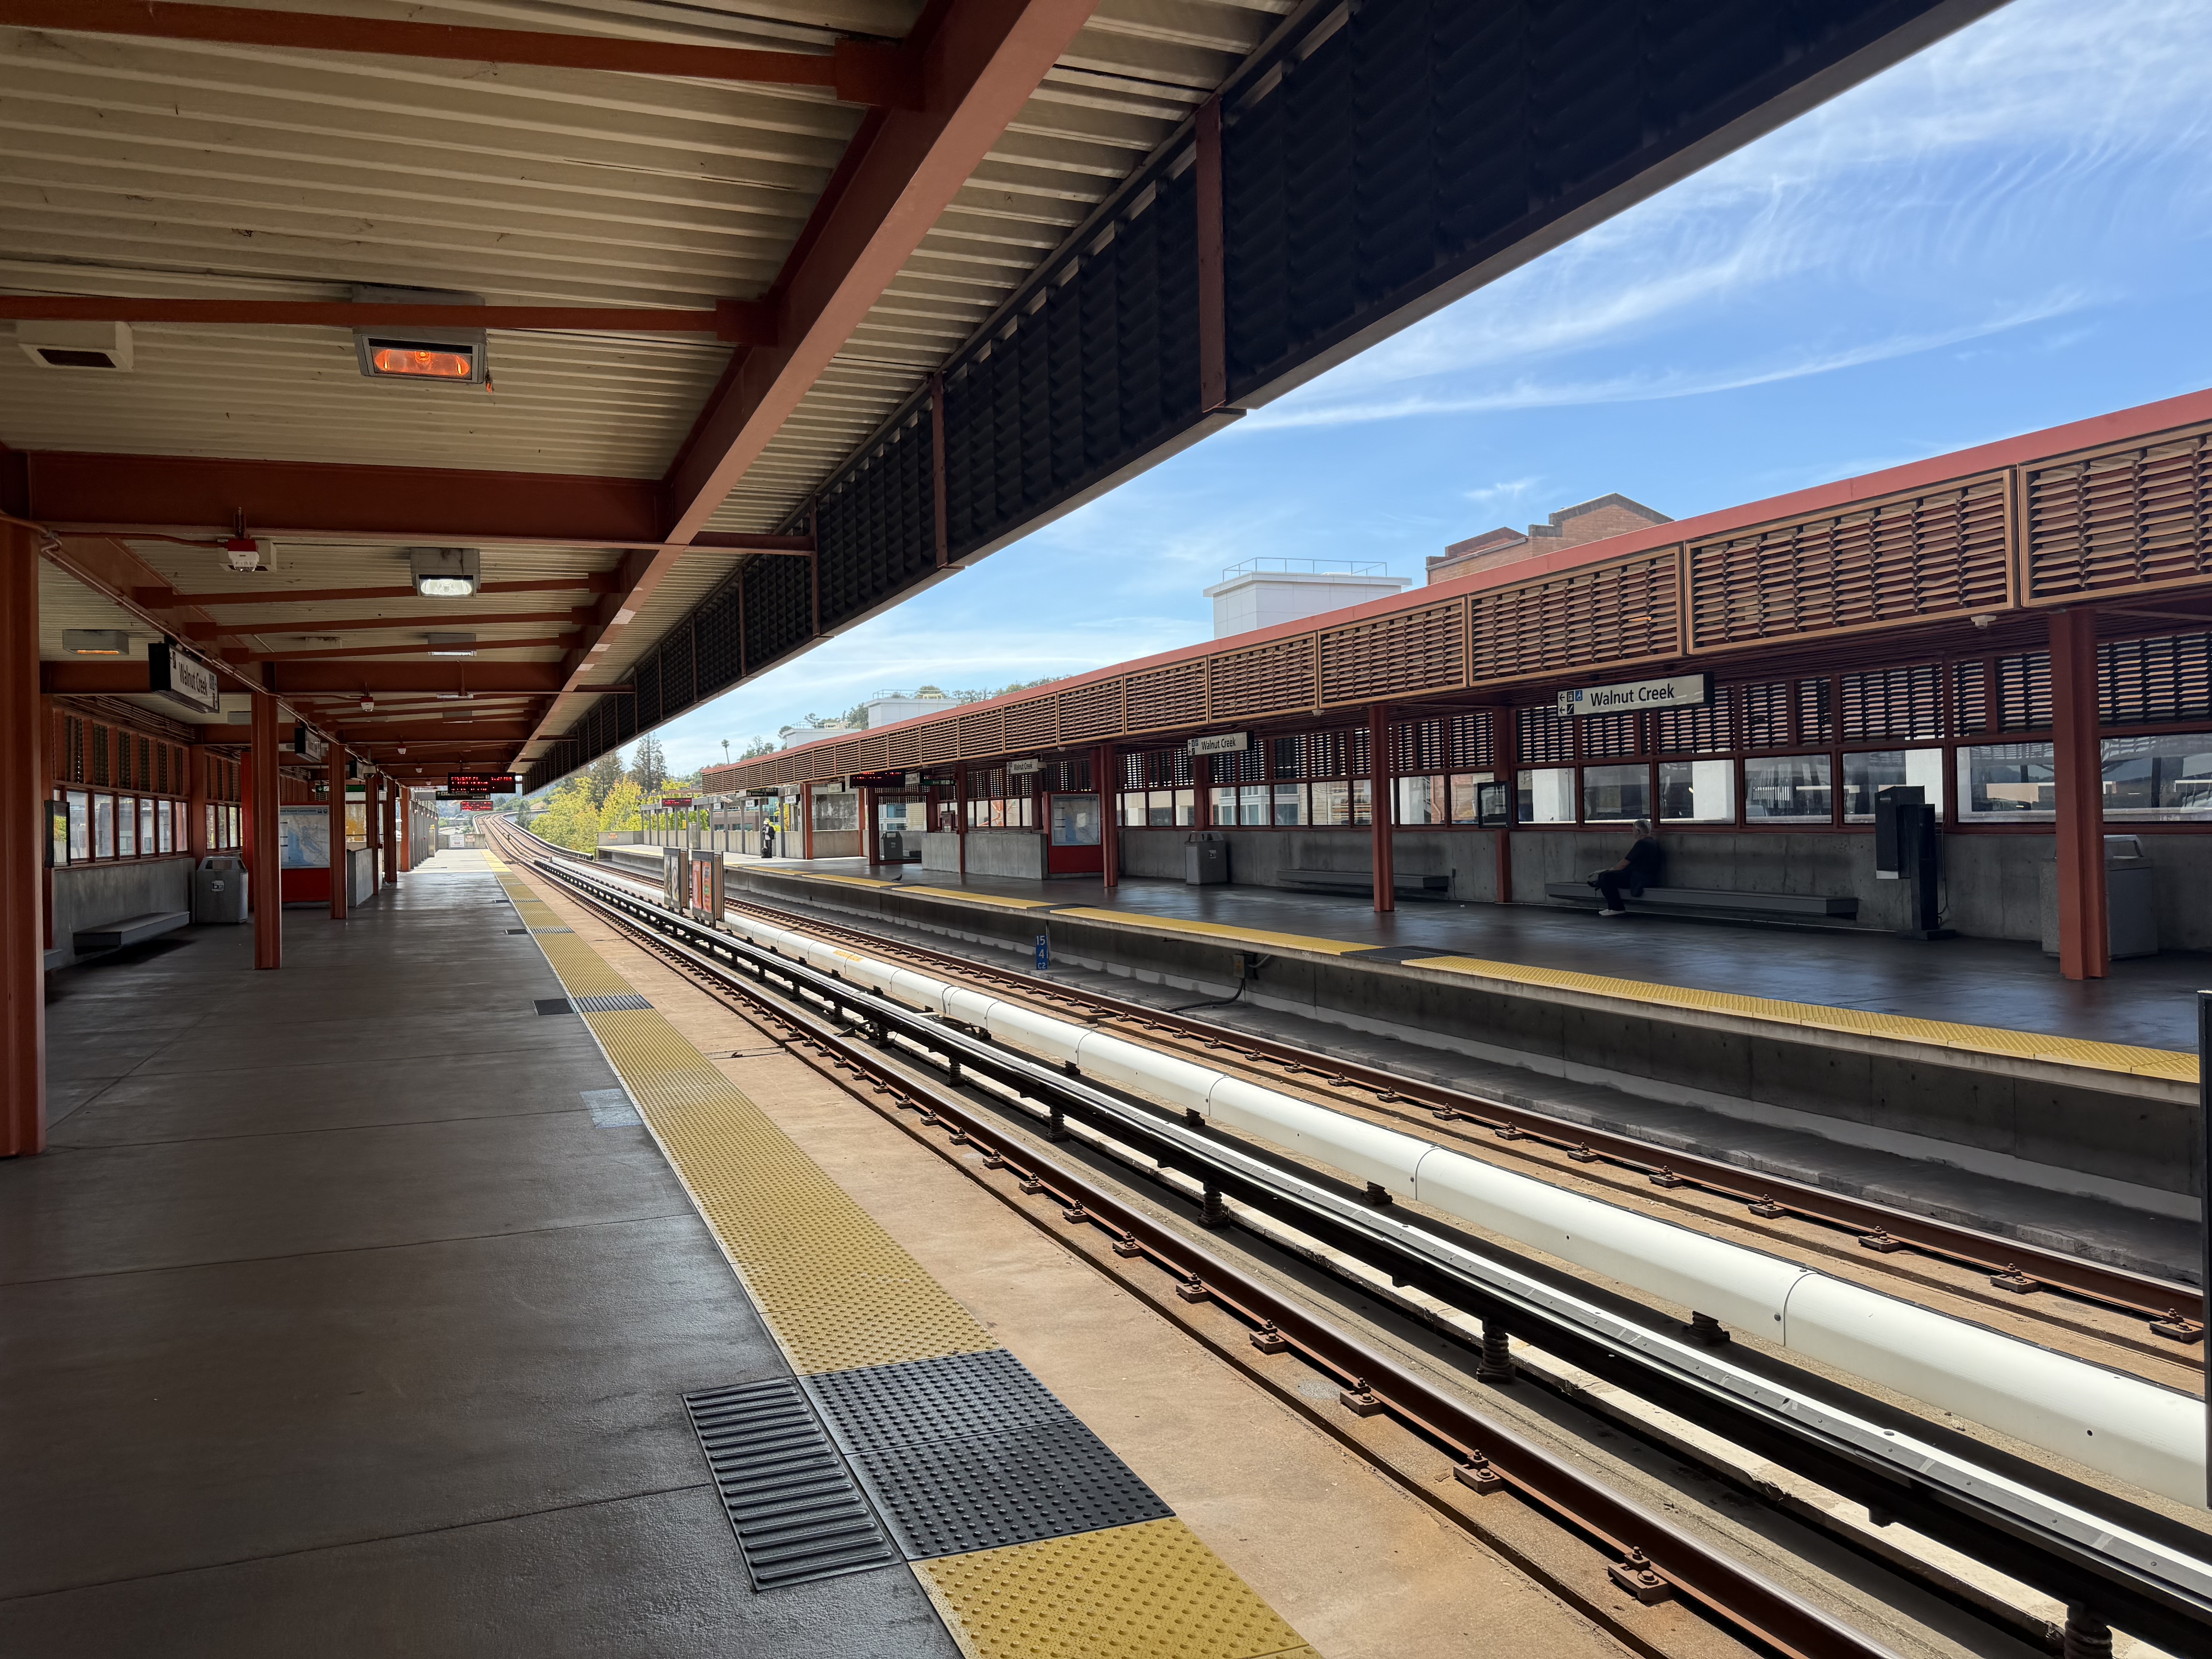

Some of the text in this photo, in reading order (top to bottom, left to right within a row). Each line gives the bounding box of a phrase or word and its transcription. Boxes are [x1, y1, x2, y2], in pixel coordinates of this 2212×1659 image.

[179, 661, 208, 696] Walnut Creek
[1590, 683, 1674, 706] Walnut Creek
[1201, 737, 1236, 750] Walnut Creek
[1024, 761, 1032, 769] Creek
[1036, 936, 1045, 945] 15
[1038, 949, 1044, 958] 4
